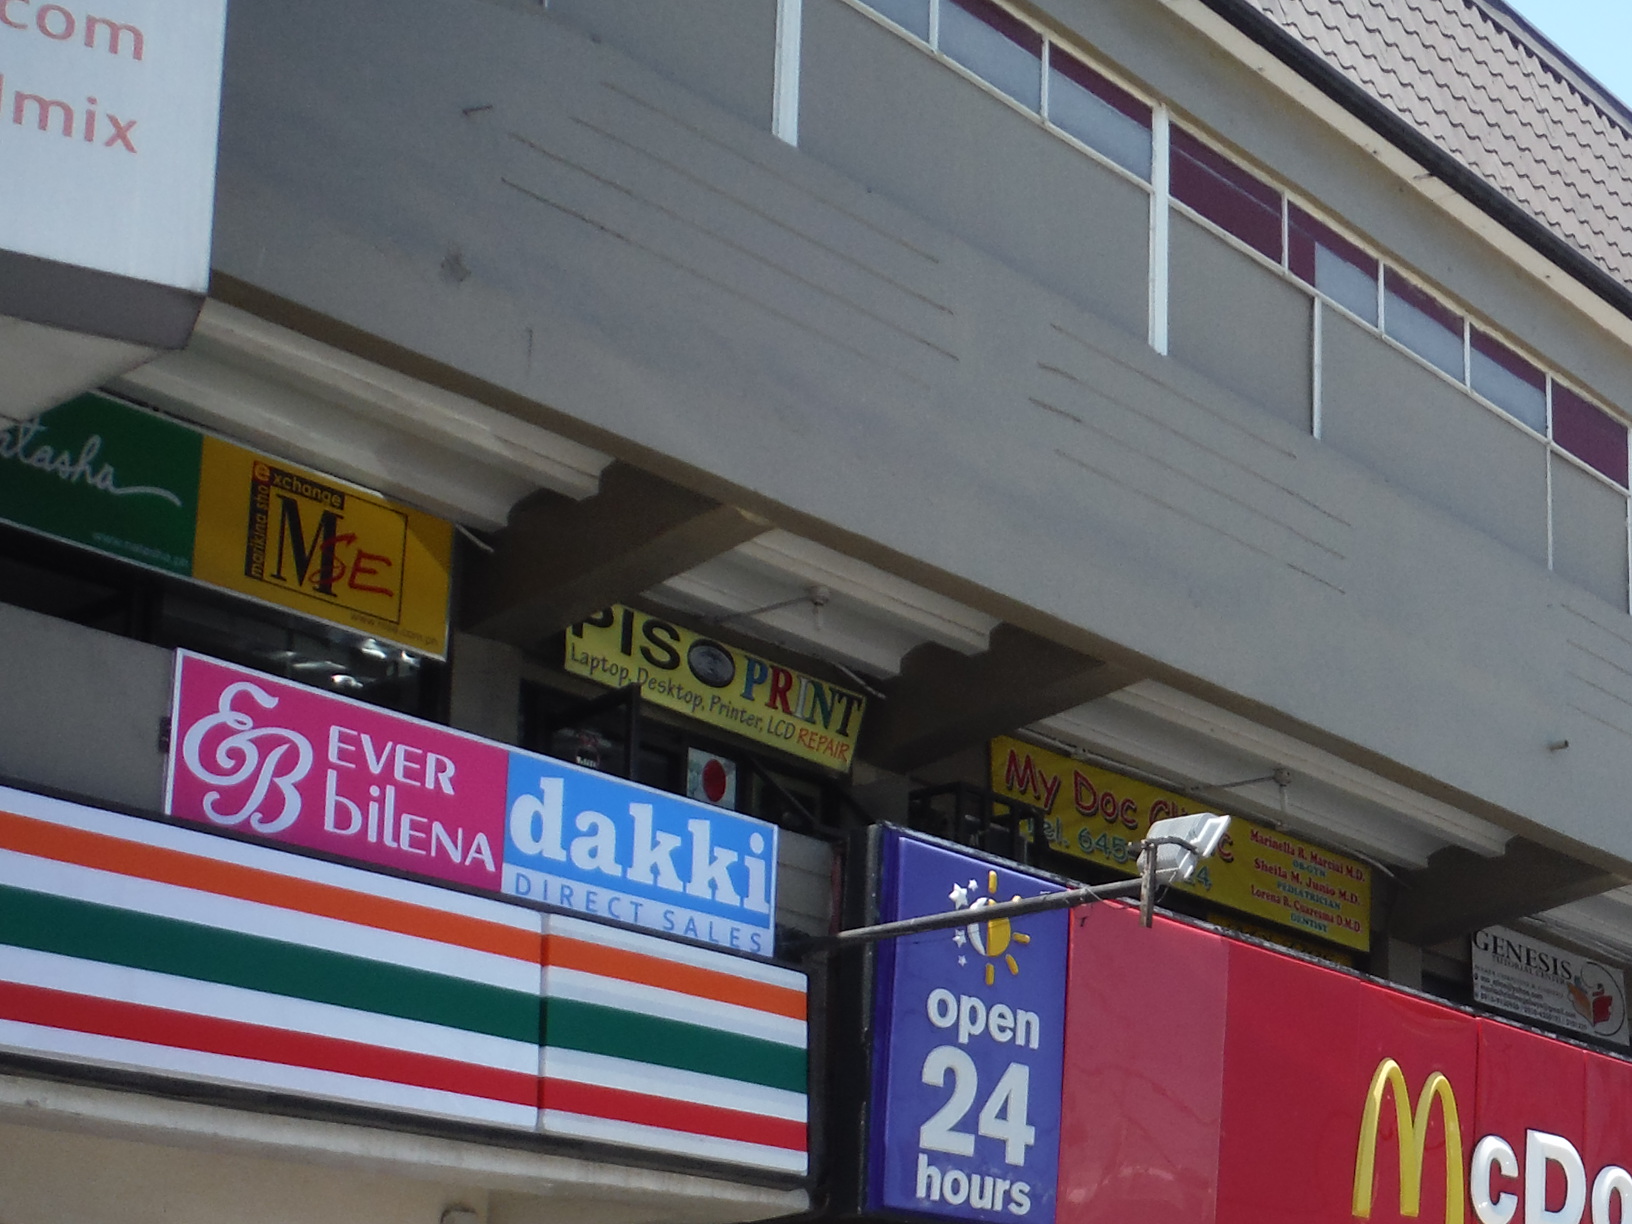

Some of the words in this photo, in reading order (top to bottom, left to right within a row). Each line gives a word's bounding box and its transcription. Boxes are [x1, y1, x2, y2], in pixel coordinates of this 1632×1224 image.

[740, 655, 864, 737] PRINT
[327, 725, 456, 796] EVER
[767, 716, 796, 740] LCD
[797, 728, 850, 763] REPAIR
[1005, 749, 1061, 814] My
[1073, 769, 1139, 830] Doc
[509, 776, 770, 914] dakki
[1253, 858, 1288, 880] Sheila
[1305, 877, 1336, 897] Junio
[515, 872, 643, 924] DIRECT
[662, 909, 762, 953] SALES
[1473, 929, 1573, 981] GENESIS
[926, 987, 1041, 1051] open
[919, 1044, 1037, 1168] 24
[915, 1152, 1032, 1217] hours
